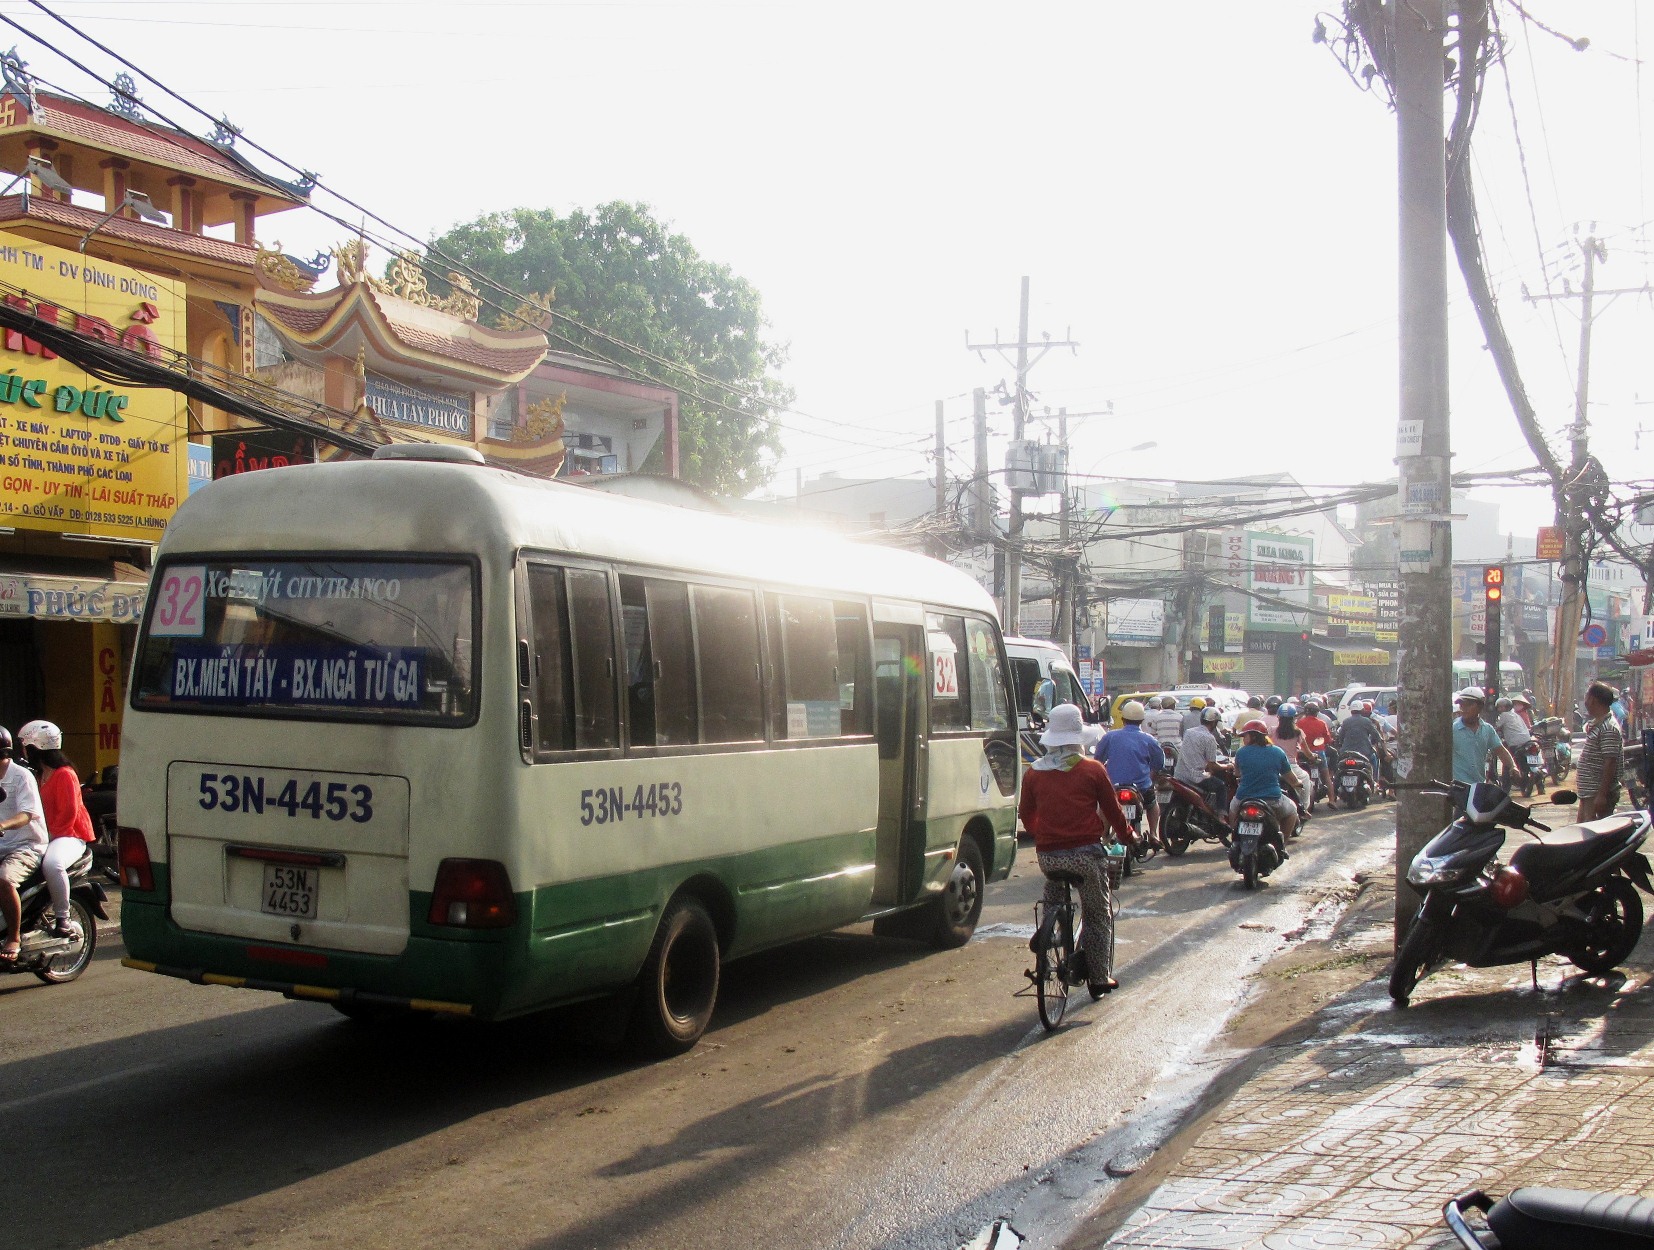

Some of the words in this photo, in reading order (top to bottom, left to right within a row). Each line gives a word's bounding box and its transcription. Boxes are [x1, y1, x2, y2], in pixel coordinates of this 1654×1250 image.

[22, 250, 44, 271] TM
[59, 261, 79, 279] DV
[83, 266, 116, 290] ĐÌNH
[120, 277, 158, 301] DŨNG
[12, 436, 48, 452] CHUYÊN
[90, 445, 101, 460] VÀ
[103, 449, 114, 461] XE
[16, 420, 28, 432] XE
[30, 421, 49, 435] MÁY
[60, 427, 92, 441] LAPTOP
[159, 443, 170, 454] XE
[8, 453, 20, 467] SỐ
[47, 460, 76, 475] THÀNH
[96, 466, 114, 480] CÁC
[3, 476, 32, 494] GỌN
[43, 480, 60, 496] UY
[63, 482, 83, 499] TÍN
[33, 502, 46, 516] GÒ
[103, 512, 116, 524] 533
[205, 571, 229, 597] Xe
[287, 577, 401, 600] CITYTRANCO
[1487, 569, 1501, 583] 20
[160, 576, 200, 626] 32
[245, 650, 277, 698] TÂY
[292, 650, 356, 699] BX.NGÃ
[364, 652, 392, 700] TƯ
[395, 660, 419, 701] GA
[936, 655, 955, 693] 32
[199, 773, 373, 823] 53N-4453
[580, 782, 682, 826] 53N-4453
[268, 889, 310, 914] 4453
